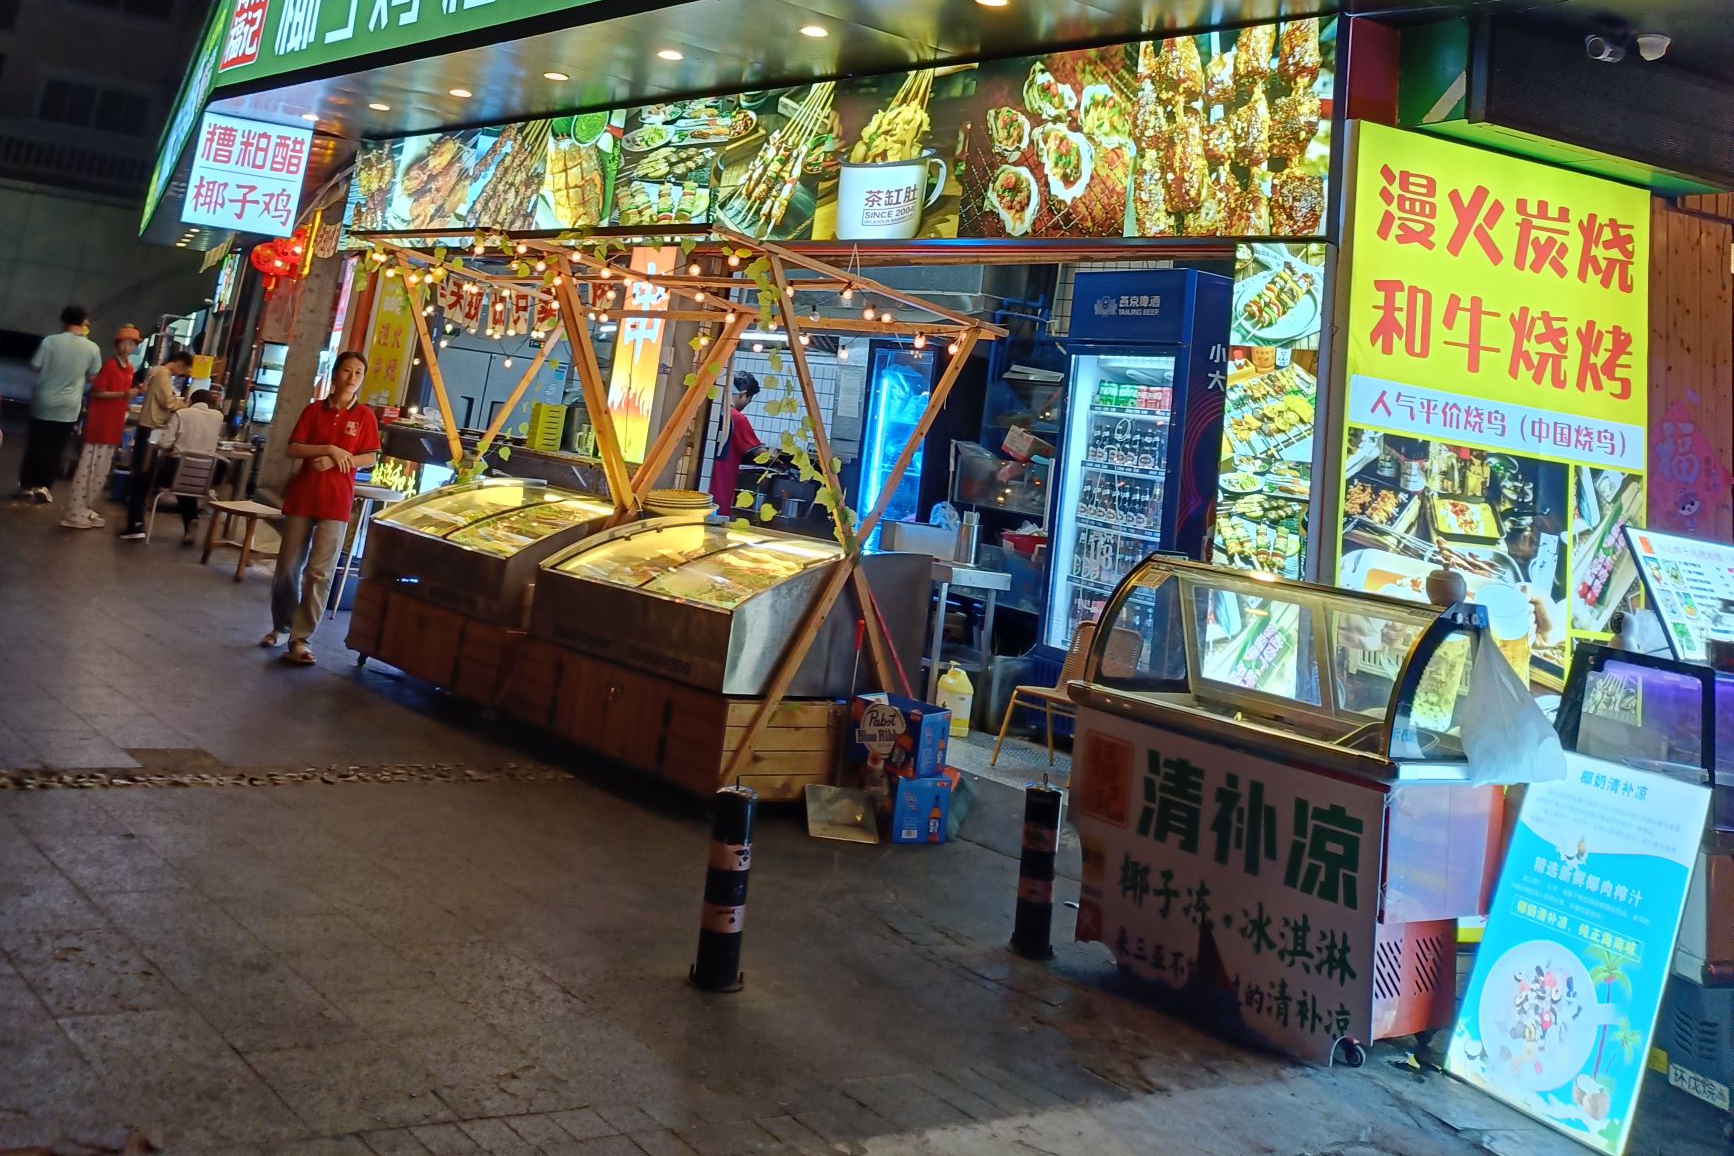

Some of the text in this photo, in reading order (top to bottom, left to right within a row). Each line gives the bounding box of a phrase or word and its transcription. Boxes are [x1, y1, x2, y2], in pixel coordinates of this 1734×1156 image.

[223, 8, 262, 64] 福记
[200, 122, 304, 176] 糟粕醋
[191, 176, 293, 227] 椰子鸡
[864, 184, 918, 207] 茶缸肚
[865, 206, 914, 219] SINCE 2004
[1376, 163, 1635, 294] 漫火炭烧
[1119, 295, 1160, 308] 燕京啤酒
[1369, 279, 1634, 400] 和牛烧烤
[1656, 421, 1700, 484] 福
[867, 709, 897, 727] Pabst
[878, 728, 898, 742] Ribb
[1580, 770, 1649, 802] 椰奶清补凉
[1136, 748, 1364, 910] 清补凉
